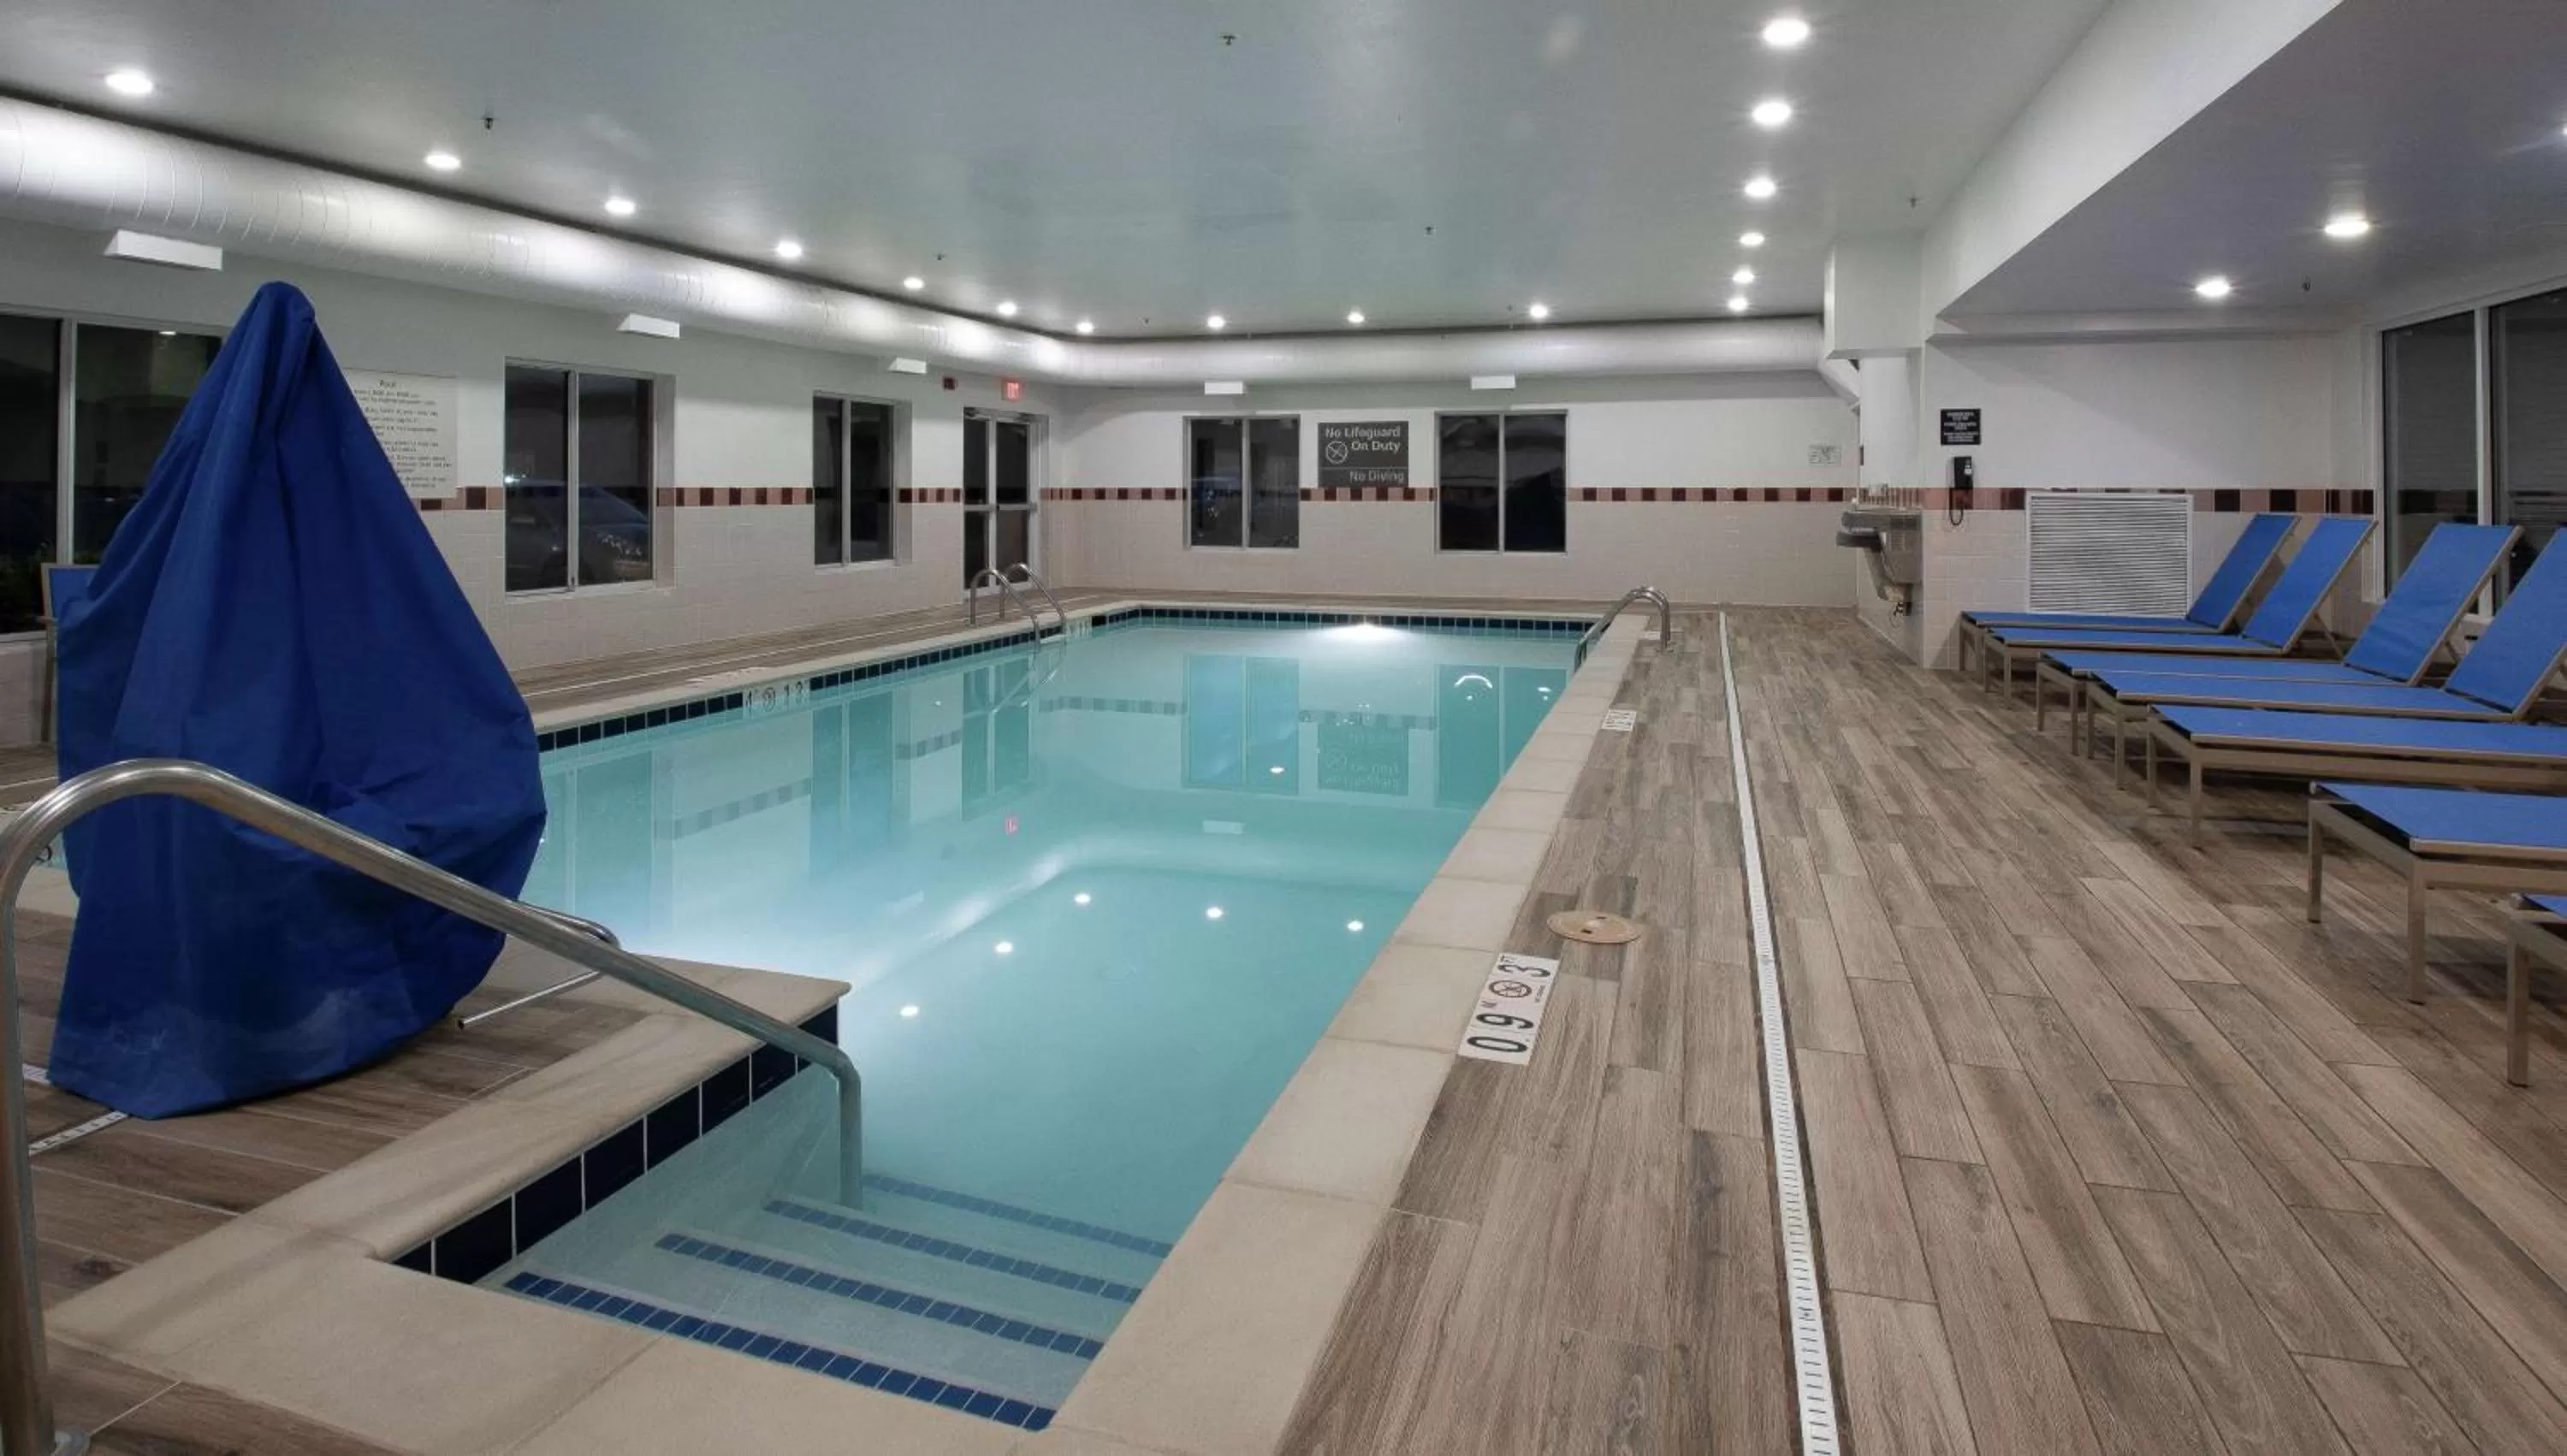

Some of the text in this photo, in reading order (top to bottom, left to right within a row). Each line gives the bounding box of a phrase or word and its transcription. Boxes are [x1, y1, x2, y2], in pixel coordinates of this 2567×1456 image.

[1325, 425, 1401, 440] No Lifeguard
[1351, 441, 1401, 454] On Duty
[1349, 470, 1404, 483] No Diving
[1497, 964, 1550, 978] 3
